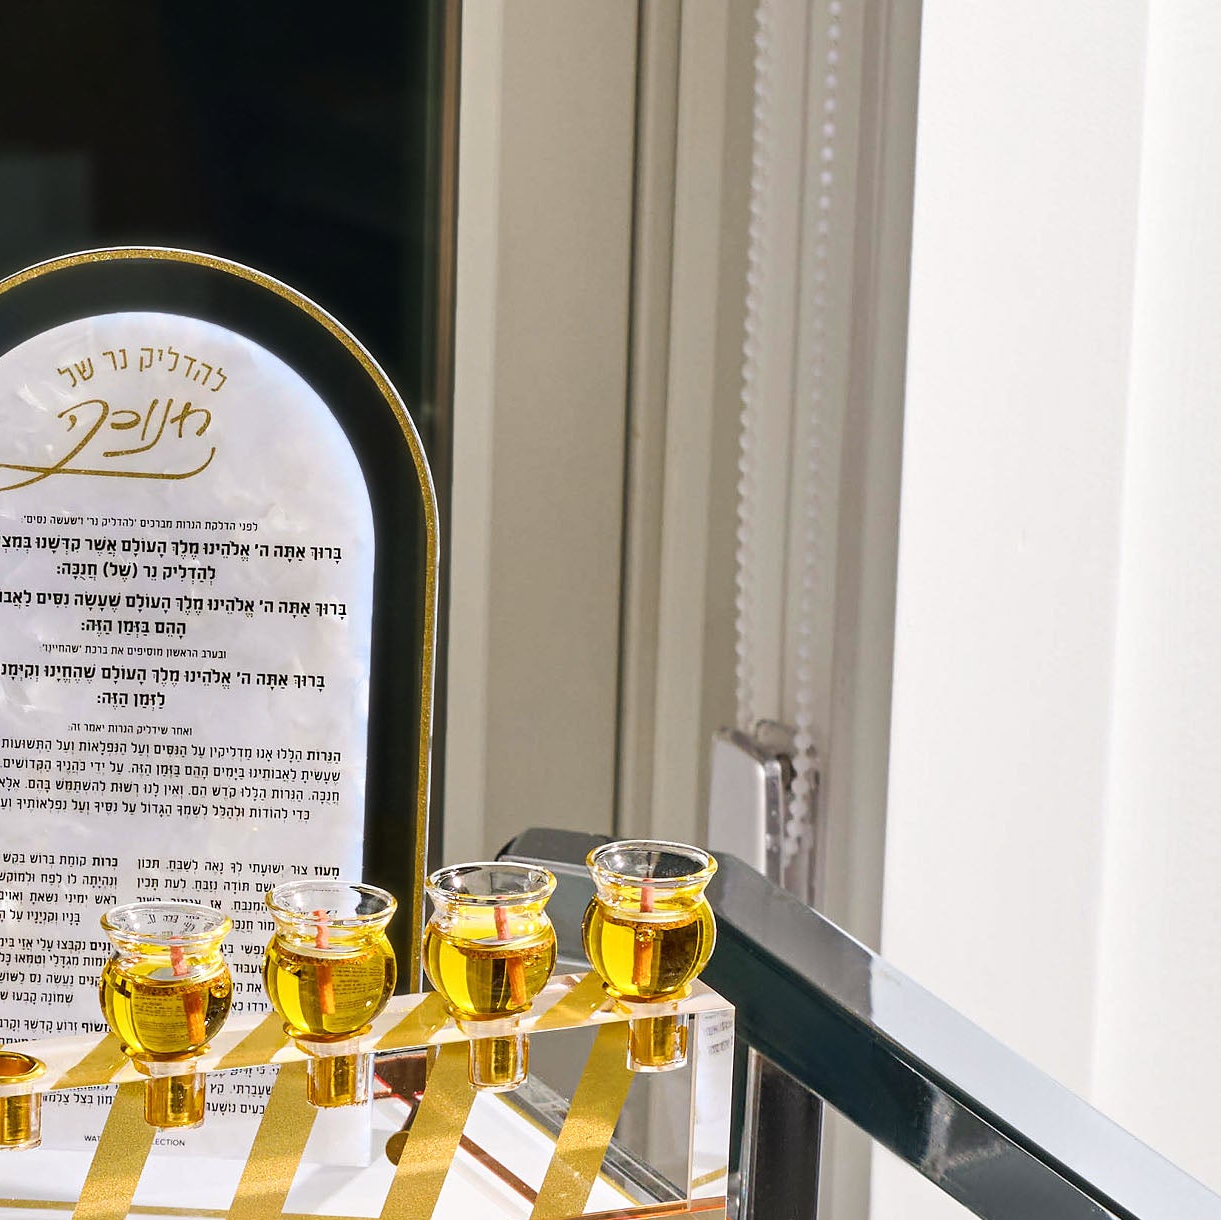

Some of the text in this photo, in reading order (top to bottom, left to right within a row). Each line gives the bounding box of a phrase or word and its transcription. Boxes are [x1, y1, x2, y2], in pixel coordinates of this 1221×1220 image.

[57, 345, 228, 392] להדליק נר של
[139, 519, 173, 529] מברכים
[175, 520, 202, 530] הנרות
[204, 520, 236, 532] הדלקת
[238, 521, 258, 532] לפני
[84, 645, 108, 655] ברכת
[110, 646, 125, 656] את
[126, 646, 164, 657] מוסיפים
[166, 648, 199, 659] הראשון
[200, 649, 227, 660] ובערב
[83, 723, 105, 733] יאמר
[107, 724, 134, 734] הנרות
[136, 724, 169, 736] שידליק
[170, 726, 193, 737] ואחר
[153, 1138, 186, 1147] ECTION
